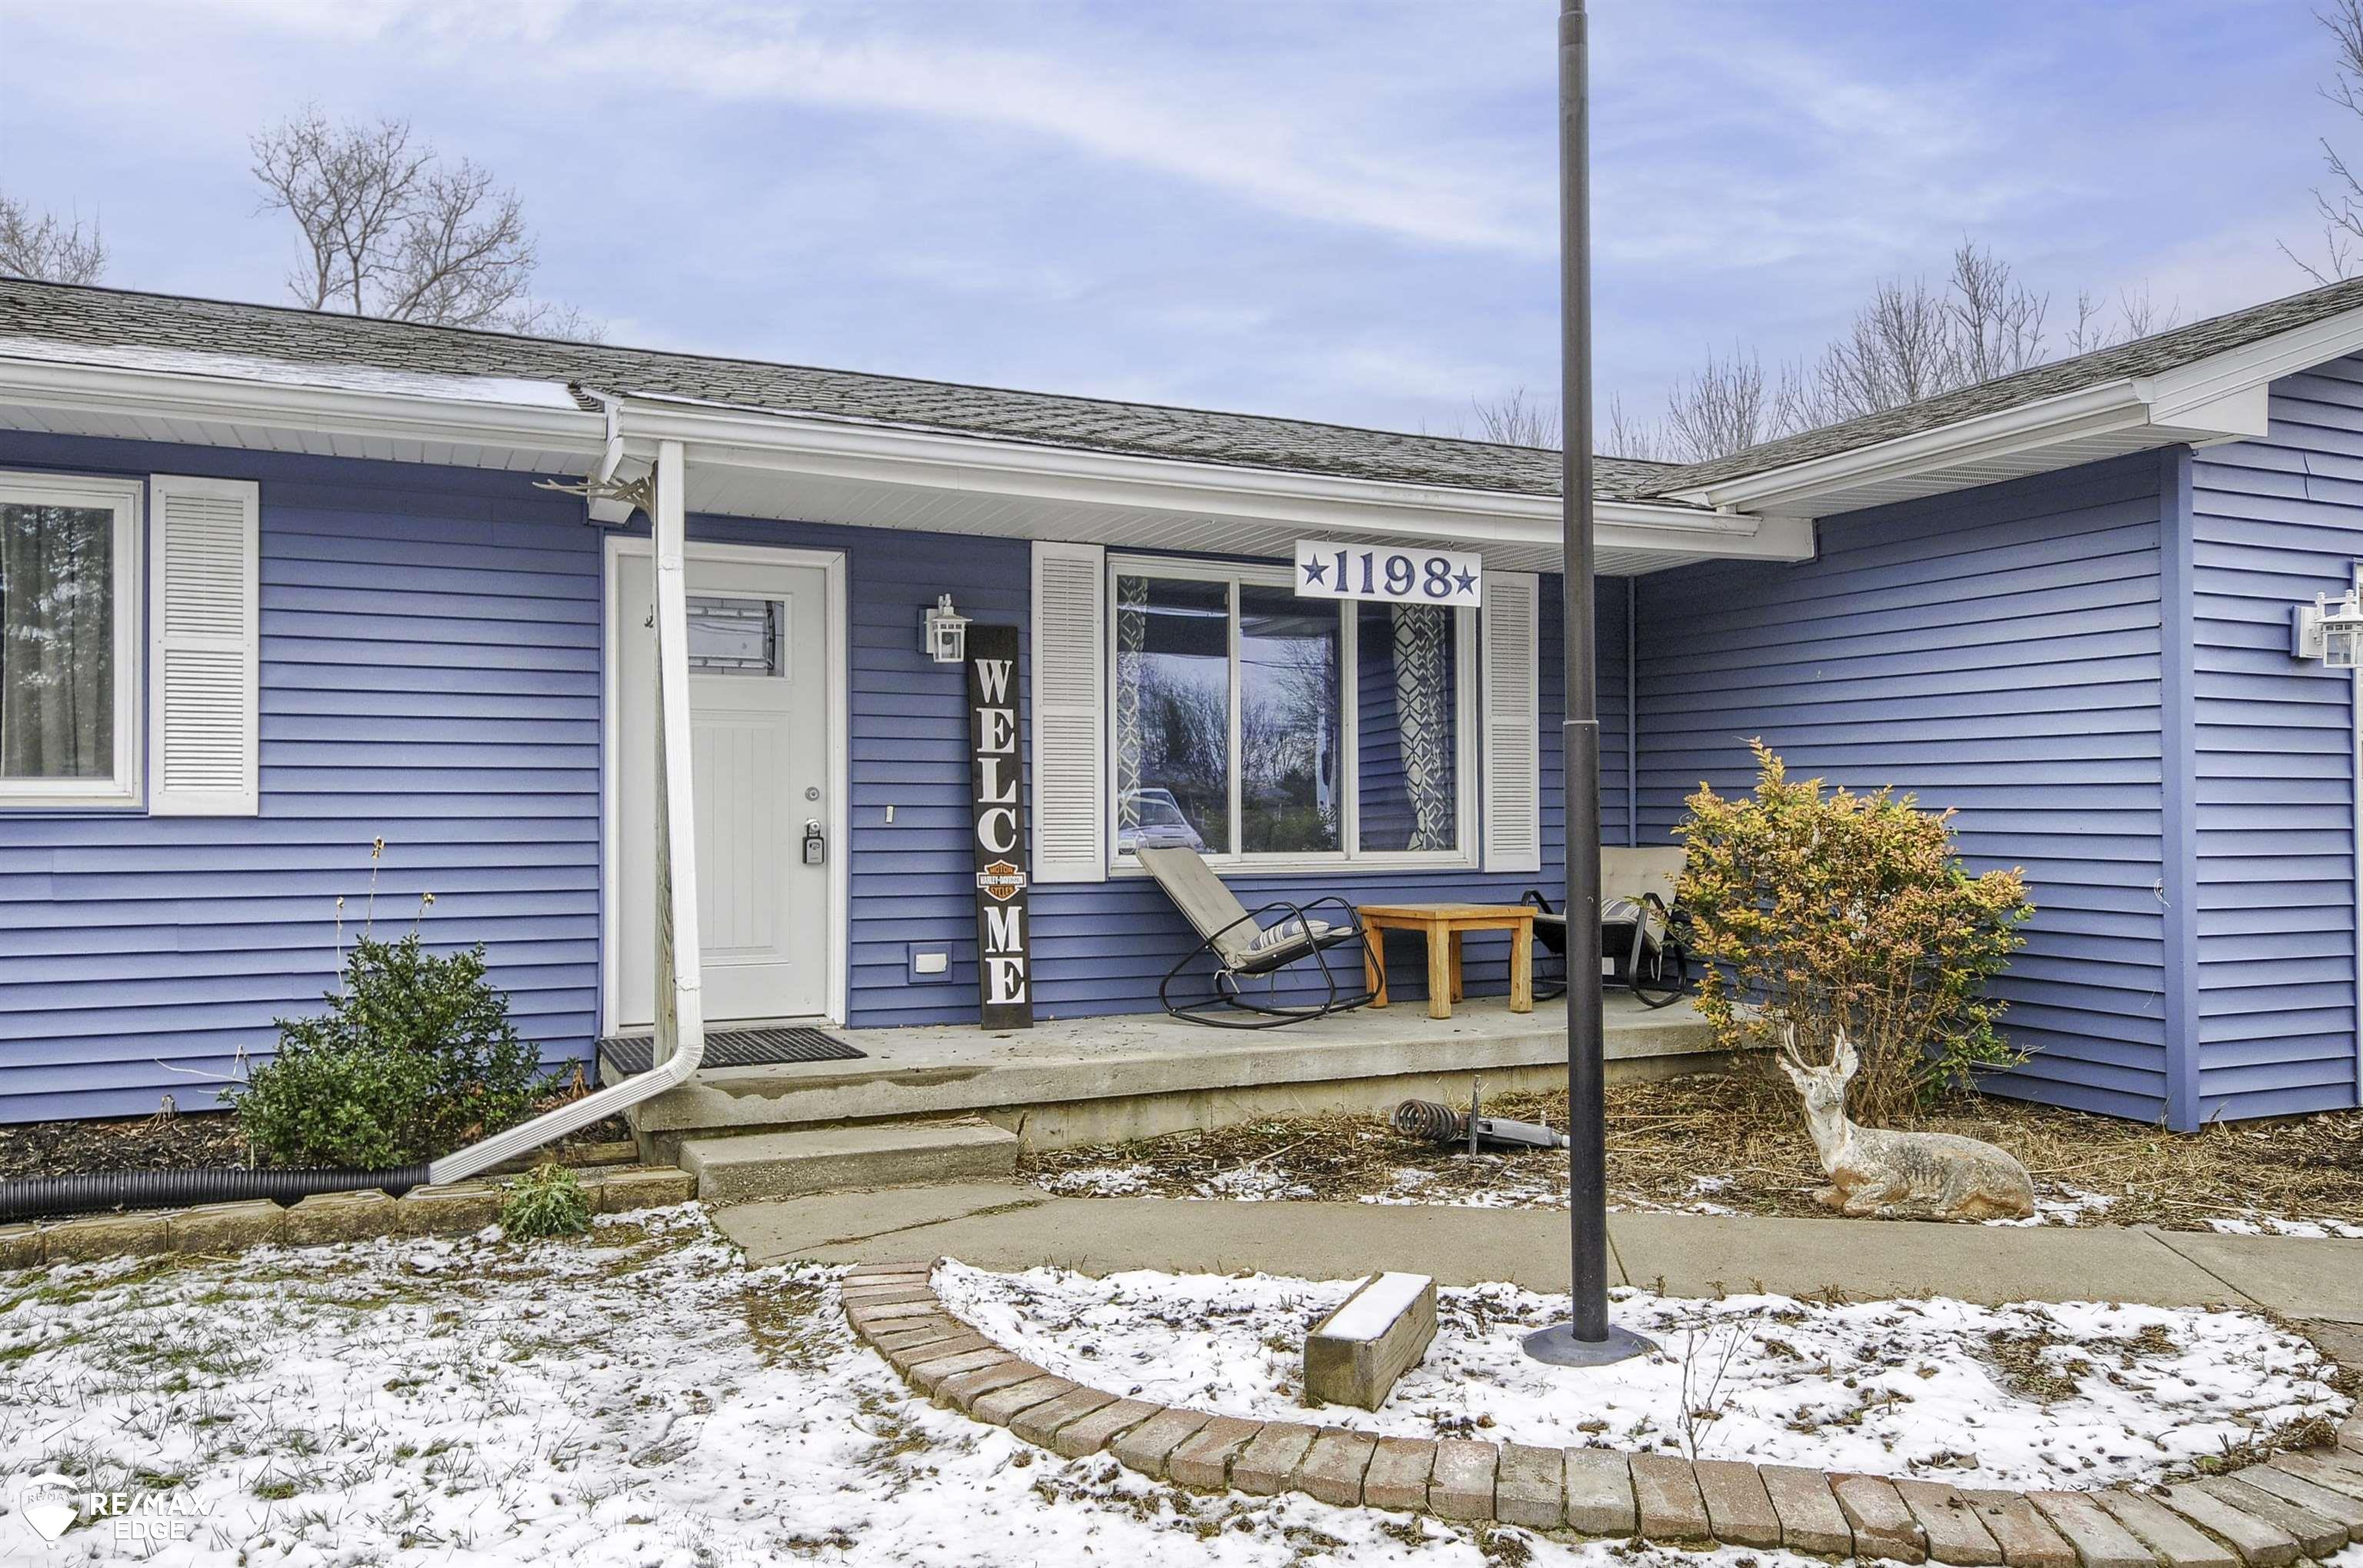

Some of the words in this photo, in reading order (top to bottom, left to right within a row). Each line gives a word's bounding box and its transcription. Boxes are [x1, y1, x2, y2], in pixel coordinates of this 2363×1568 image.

[1335, 550, 1452, 598] 1198
[975, 658, 1025, 1005] WELCME
[990, 864, 1013, 873] MOTOR
